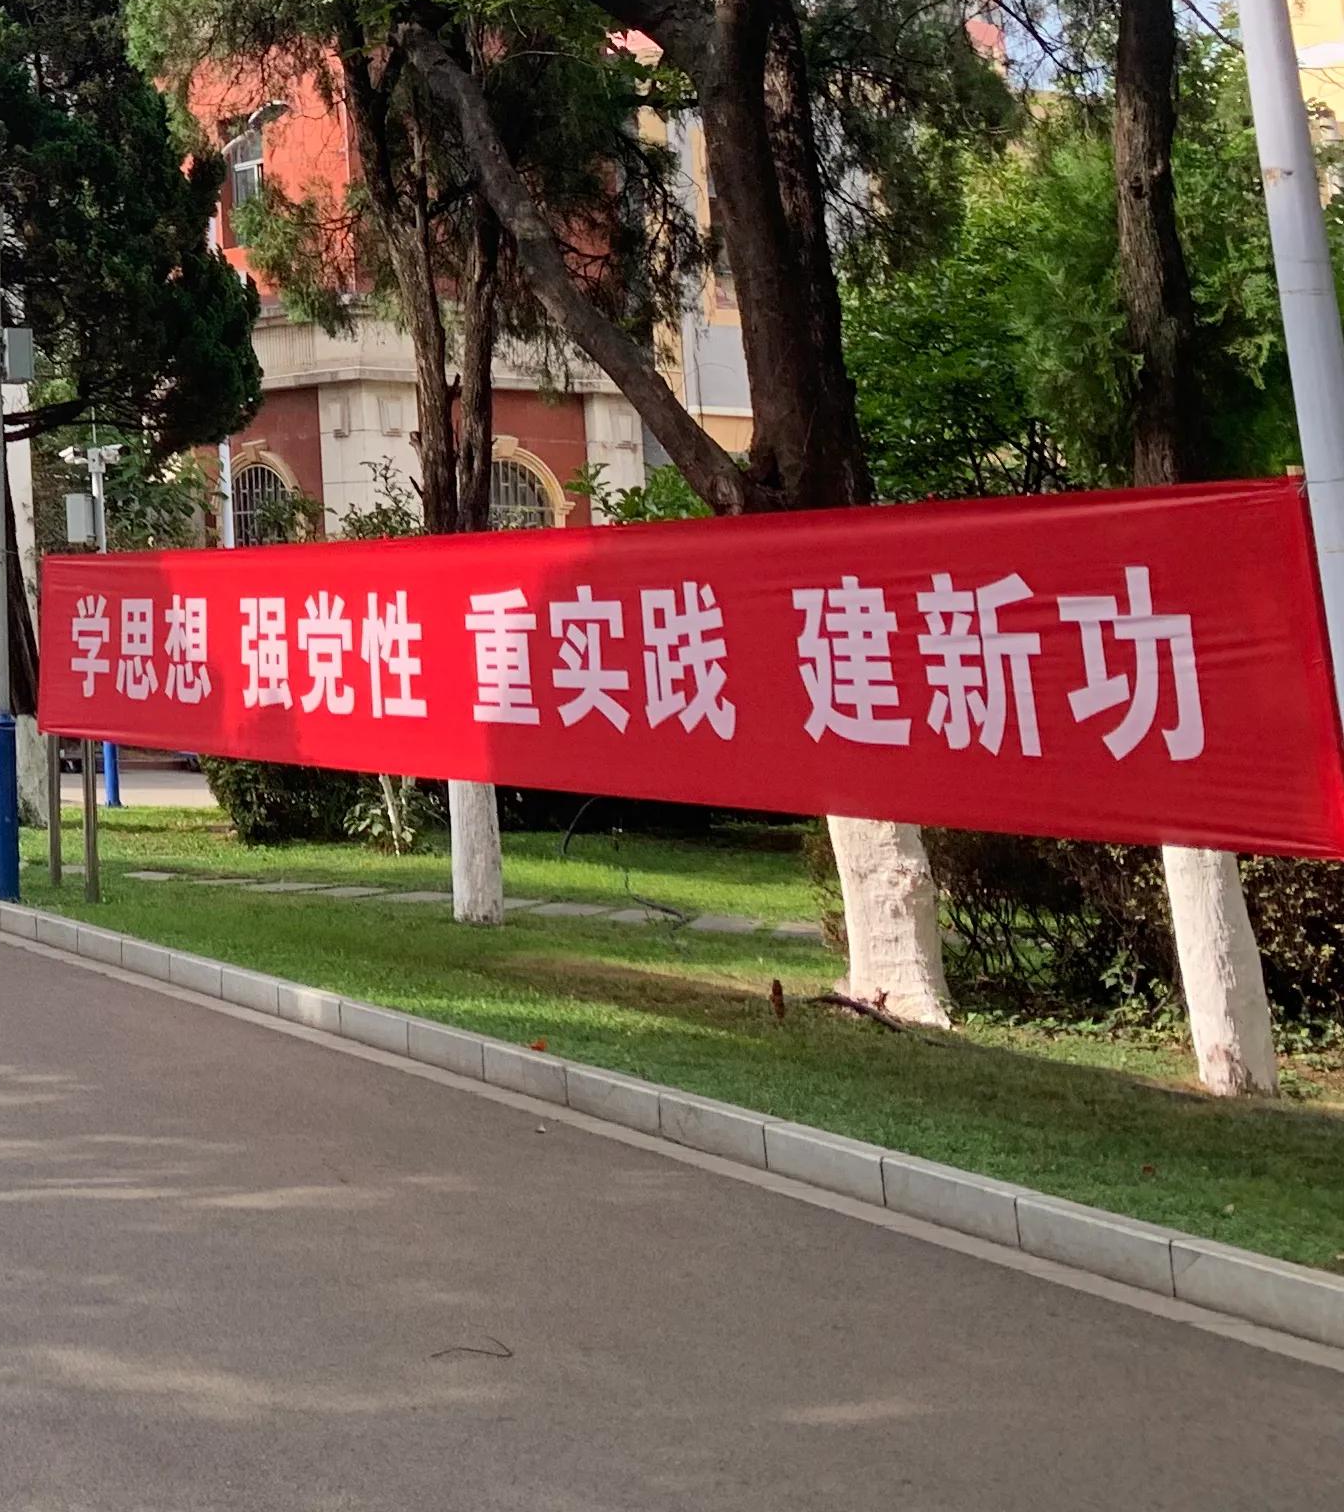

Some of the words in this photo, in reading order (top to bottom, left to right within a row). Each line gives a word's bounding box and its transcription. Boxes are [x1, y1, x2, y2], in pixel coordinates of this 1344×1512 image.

[70, 593, 211, 703] 学思想
[239, 589, 428, 719] 强党性
[464, 580, 736, 741] 重实践
[792, 565, 1205, 762] 建新功
